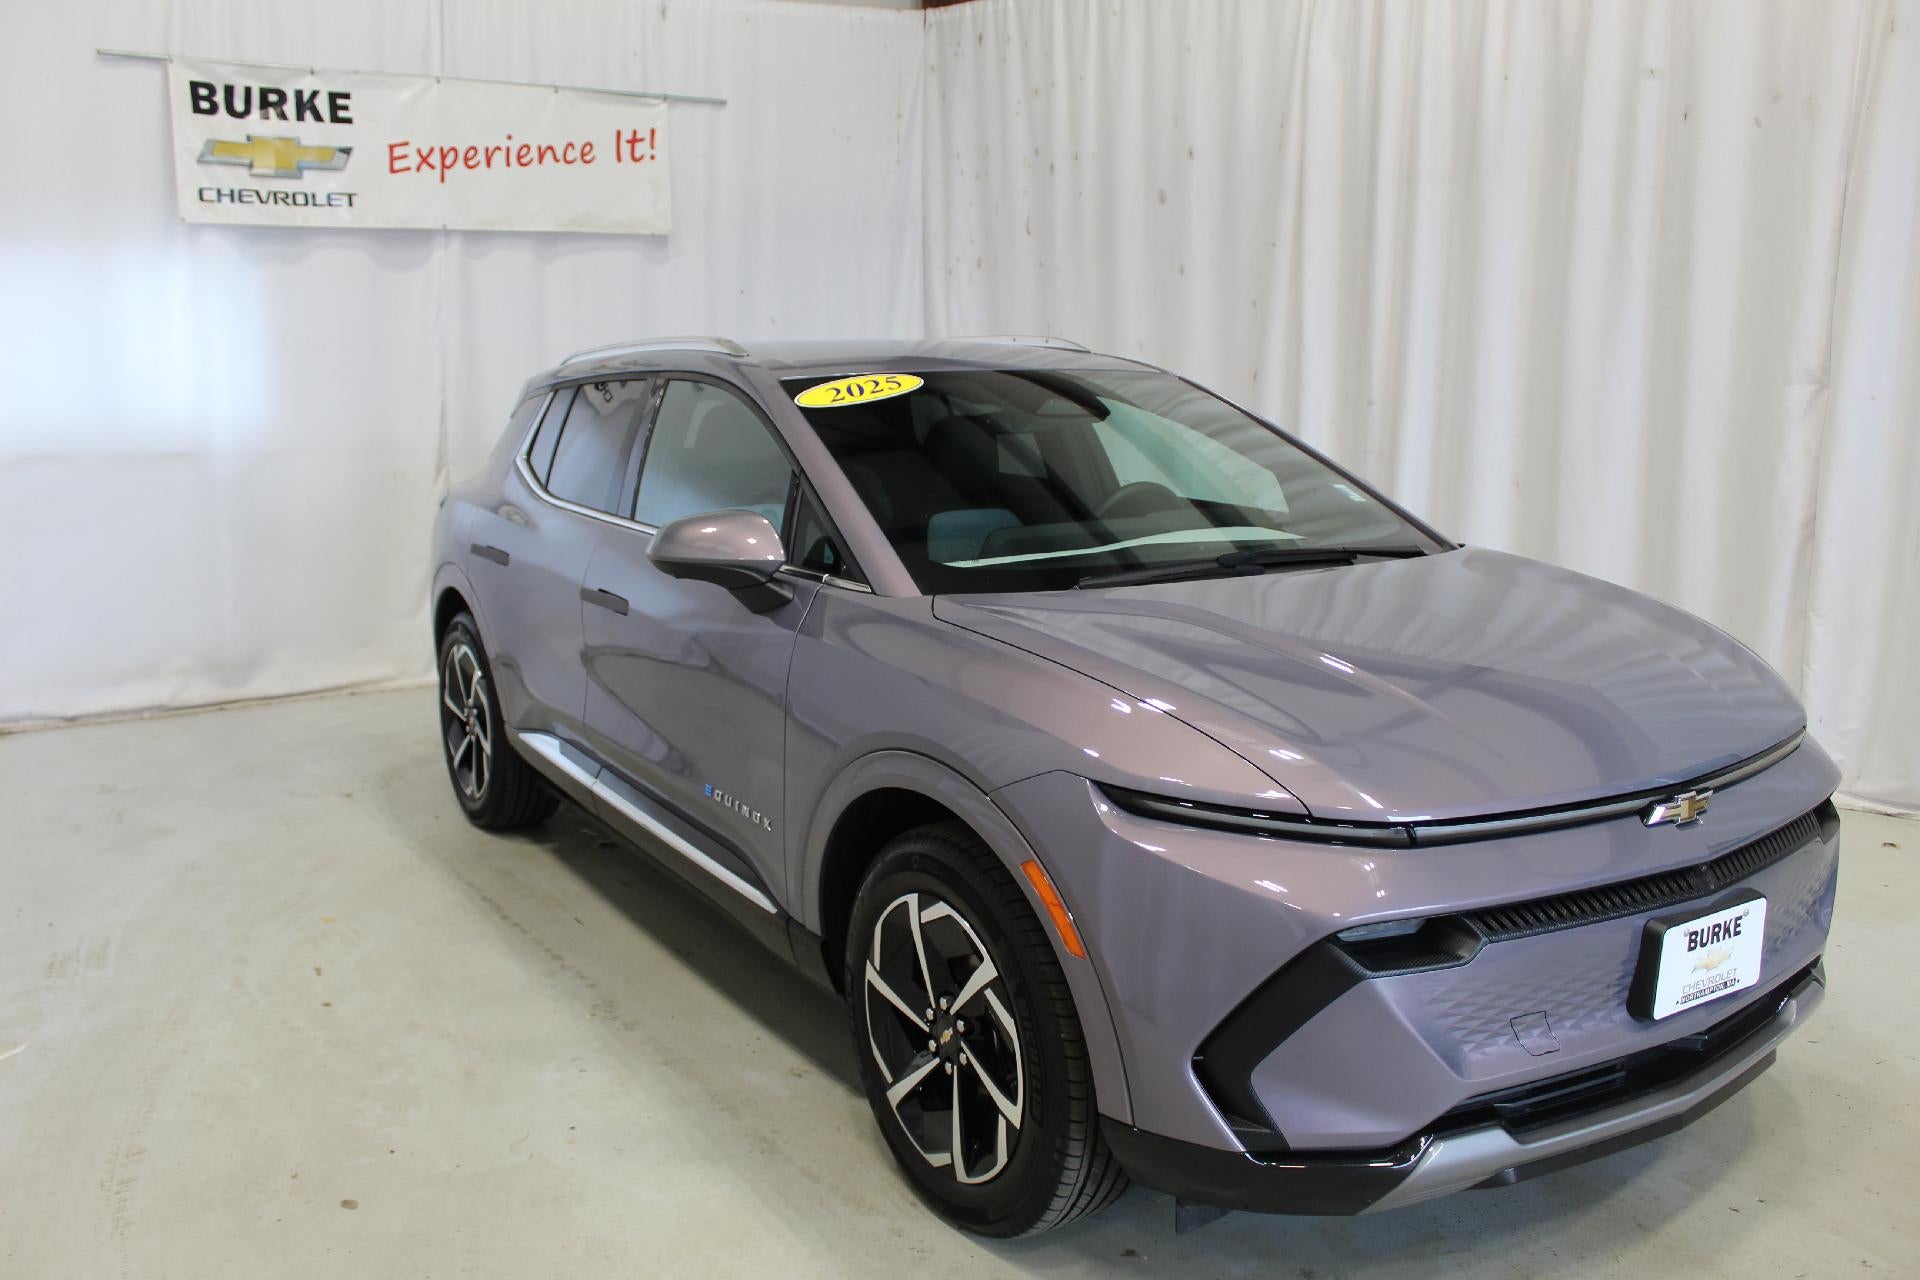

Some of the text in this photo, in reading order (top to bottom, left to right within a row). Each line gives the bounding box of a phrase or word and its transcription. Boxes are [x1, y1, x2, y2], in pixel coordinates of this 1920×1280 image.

[189, 80, 353, 124] BURKE
[387, 127, 657, 184] Experience It!
[198, 187, 358, 208] CHEVROLET
[825, 376, 902, 403] 2025
[704, 783, 772, 832] EQUINOX
[1686, 915, 1743, 953] BURKE
[1682, 967, 1738, 994] CHEVROLET
